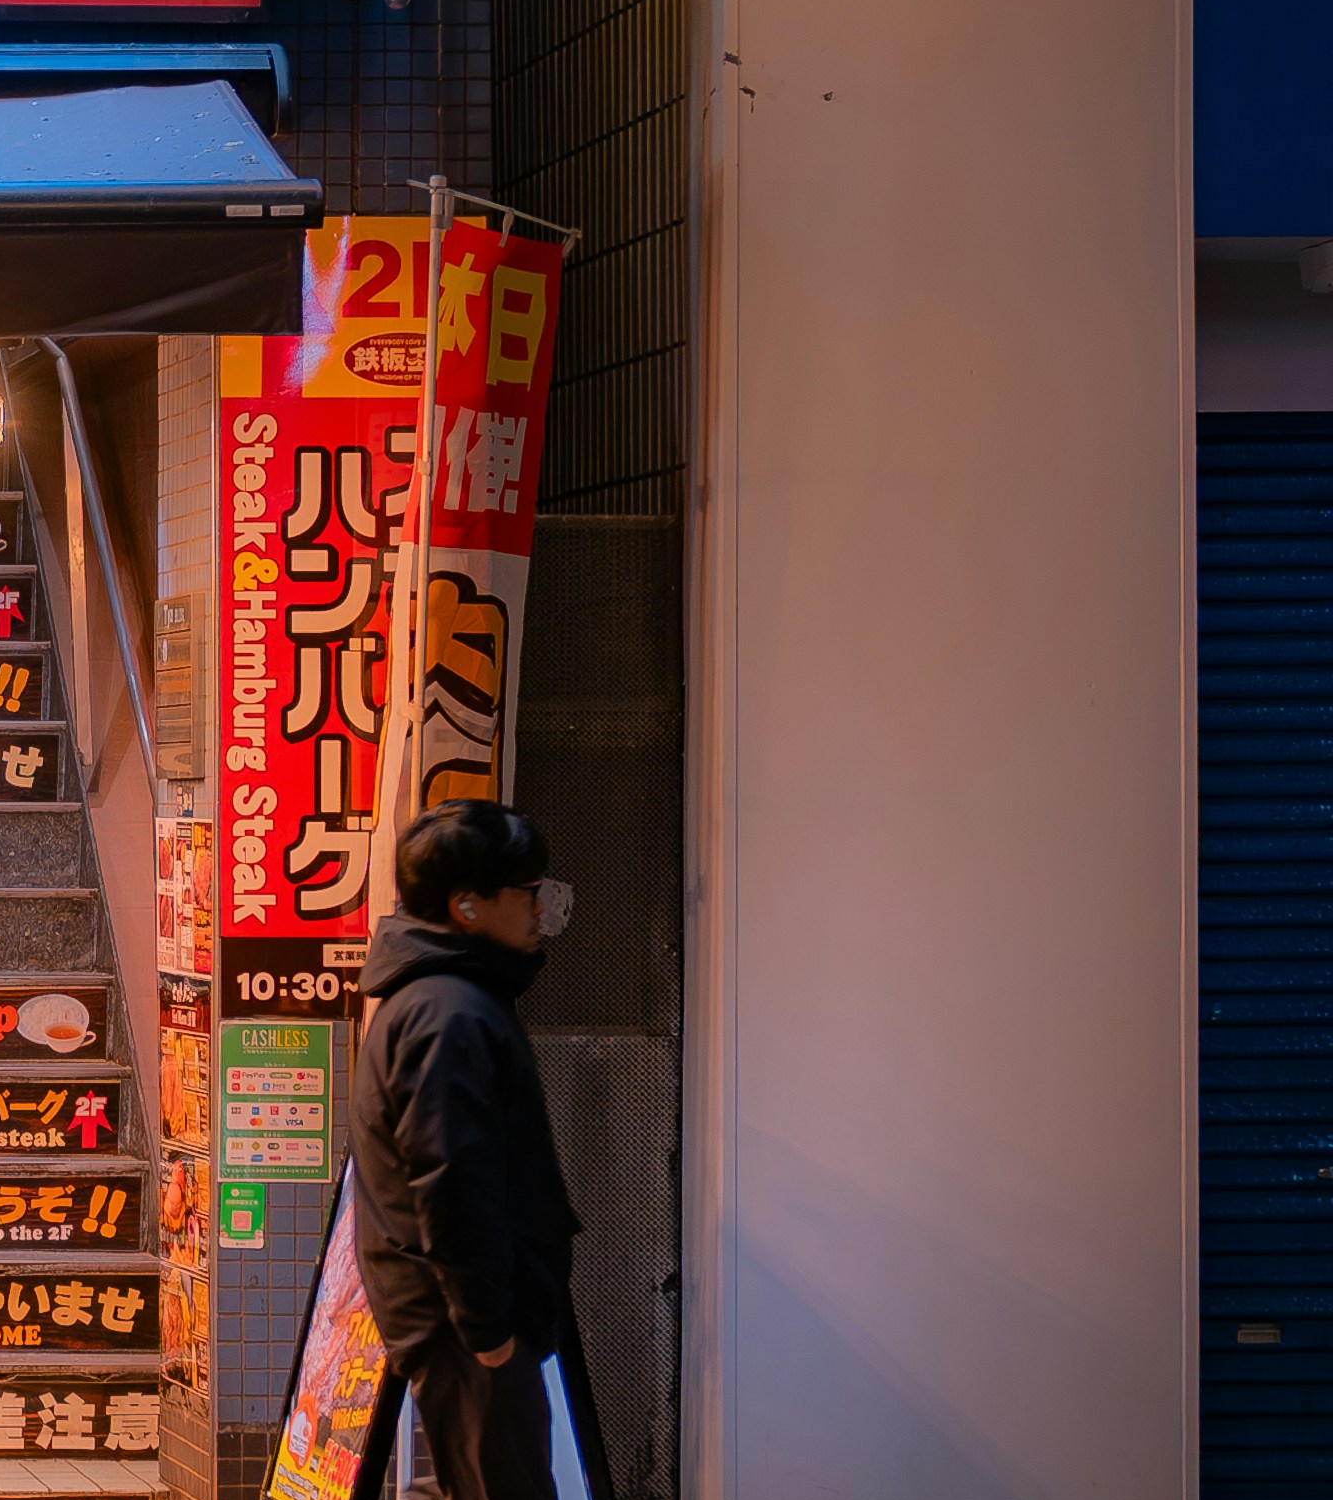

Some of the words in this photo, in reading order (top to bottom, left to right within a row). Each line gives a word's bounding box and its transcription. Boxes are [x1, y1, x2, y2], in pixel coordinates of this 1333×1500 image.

[343, 240, 430, 318] 2
[233, 412, 277, 770] Steak&Hamburg
[284, 446, 383, 921] ハンバーグ
[233, 784, 277, 925] Steak
[241, 1029, 309, 1047] CASHLESS
[75, 1097, 108, 1117] 2F
[10, 1225, 42, 1242] the
[48, 1224, 74, 1241] 2F
